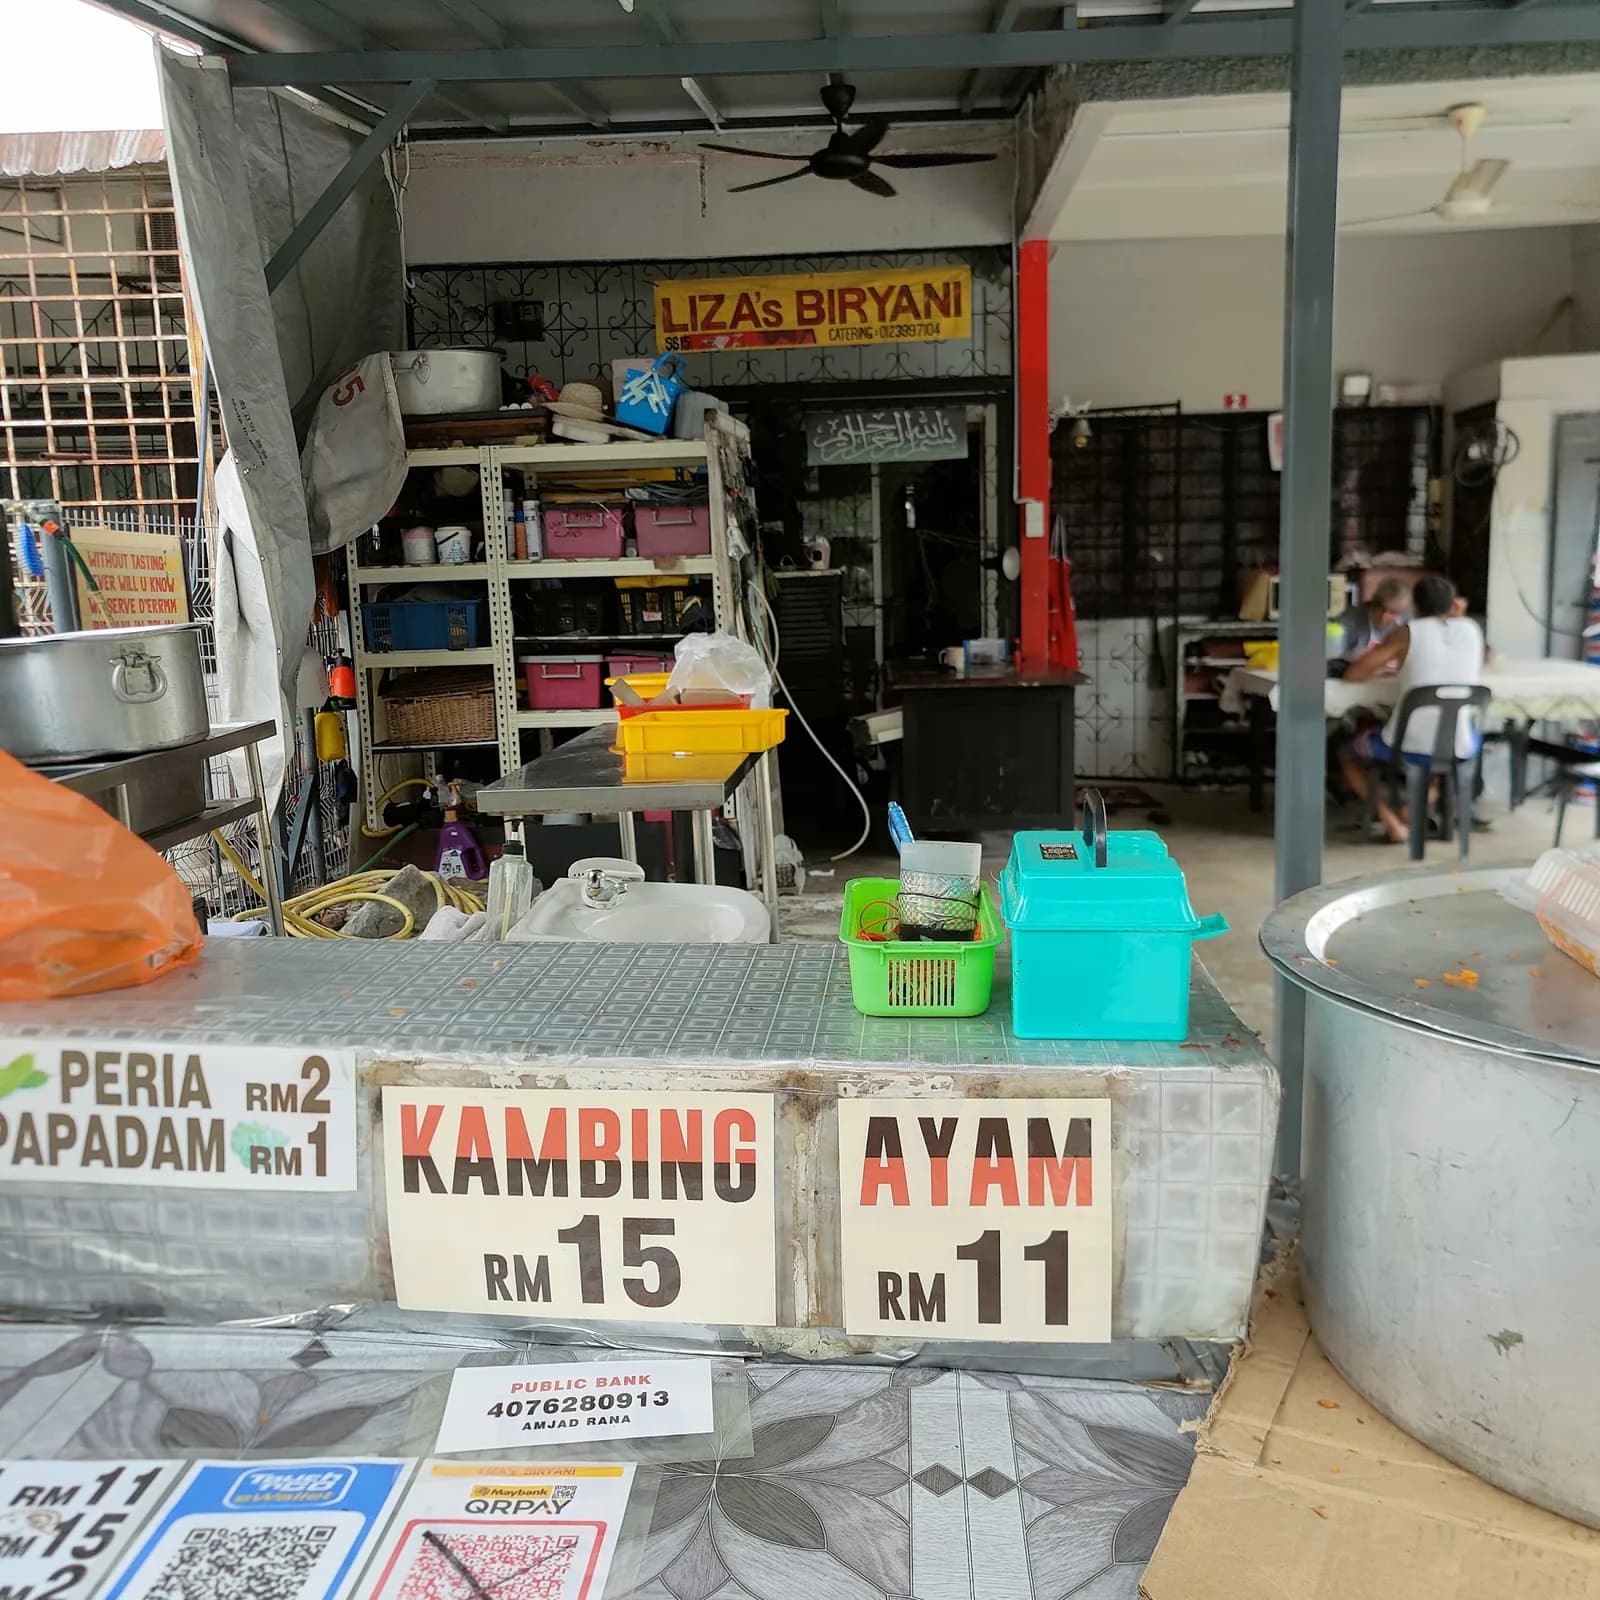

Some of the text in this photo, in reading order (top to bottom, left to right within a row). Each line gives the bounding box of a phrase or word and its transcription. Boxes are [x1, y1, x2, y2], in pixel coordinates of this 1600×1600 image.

[661, 281, 961, 333] LIZA's BIRYANI
[87, 551, 128, 569] WITHOUT
[118, 575, 139, 592] WILL
[141, 576, 147, 592] U
[150, 577, 175, 593] KNOW
[107, 598, 137, 614] SERVE
[61, 1050, 212, 1109] PERIA
[400, 1104, 757, 1203] KAMBING
[860, 1116, 1093, 1207] AYAM
[510, 1374, 652, 1394] PUBLIC BANK
[487, 1390, 670, 1418] 4076280913
[521, 1414, 632, 1431] AMJAD RANA
[490, 1489, 548, 1497] Maybank
[465, 1499, 572, 1514] QRPAY
